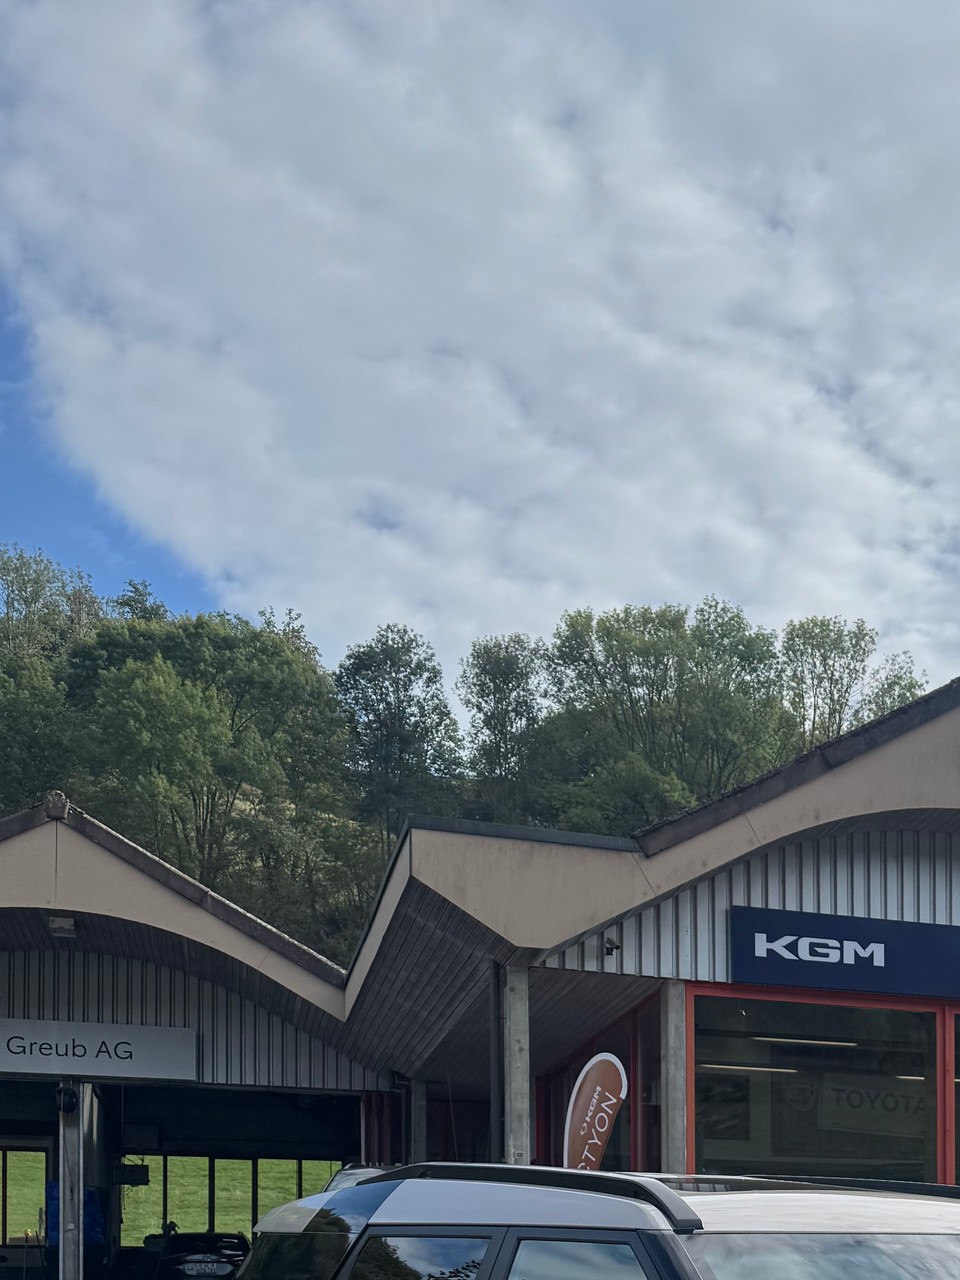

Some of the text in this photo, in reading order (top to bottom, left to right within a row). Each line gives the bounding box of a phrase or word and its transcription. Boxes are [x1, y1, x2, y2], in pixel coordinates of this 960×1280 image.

[754, 932, 885, 967] KGM
[6, 1036, 133, 1060] Greub AG
